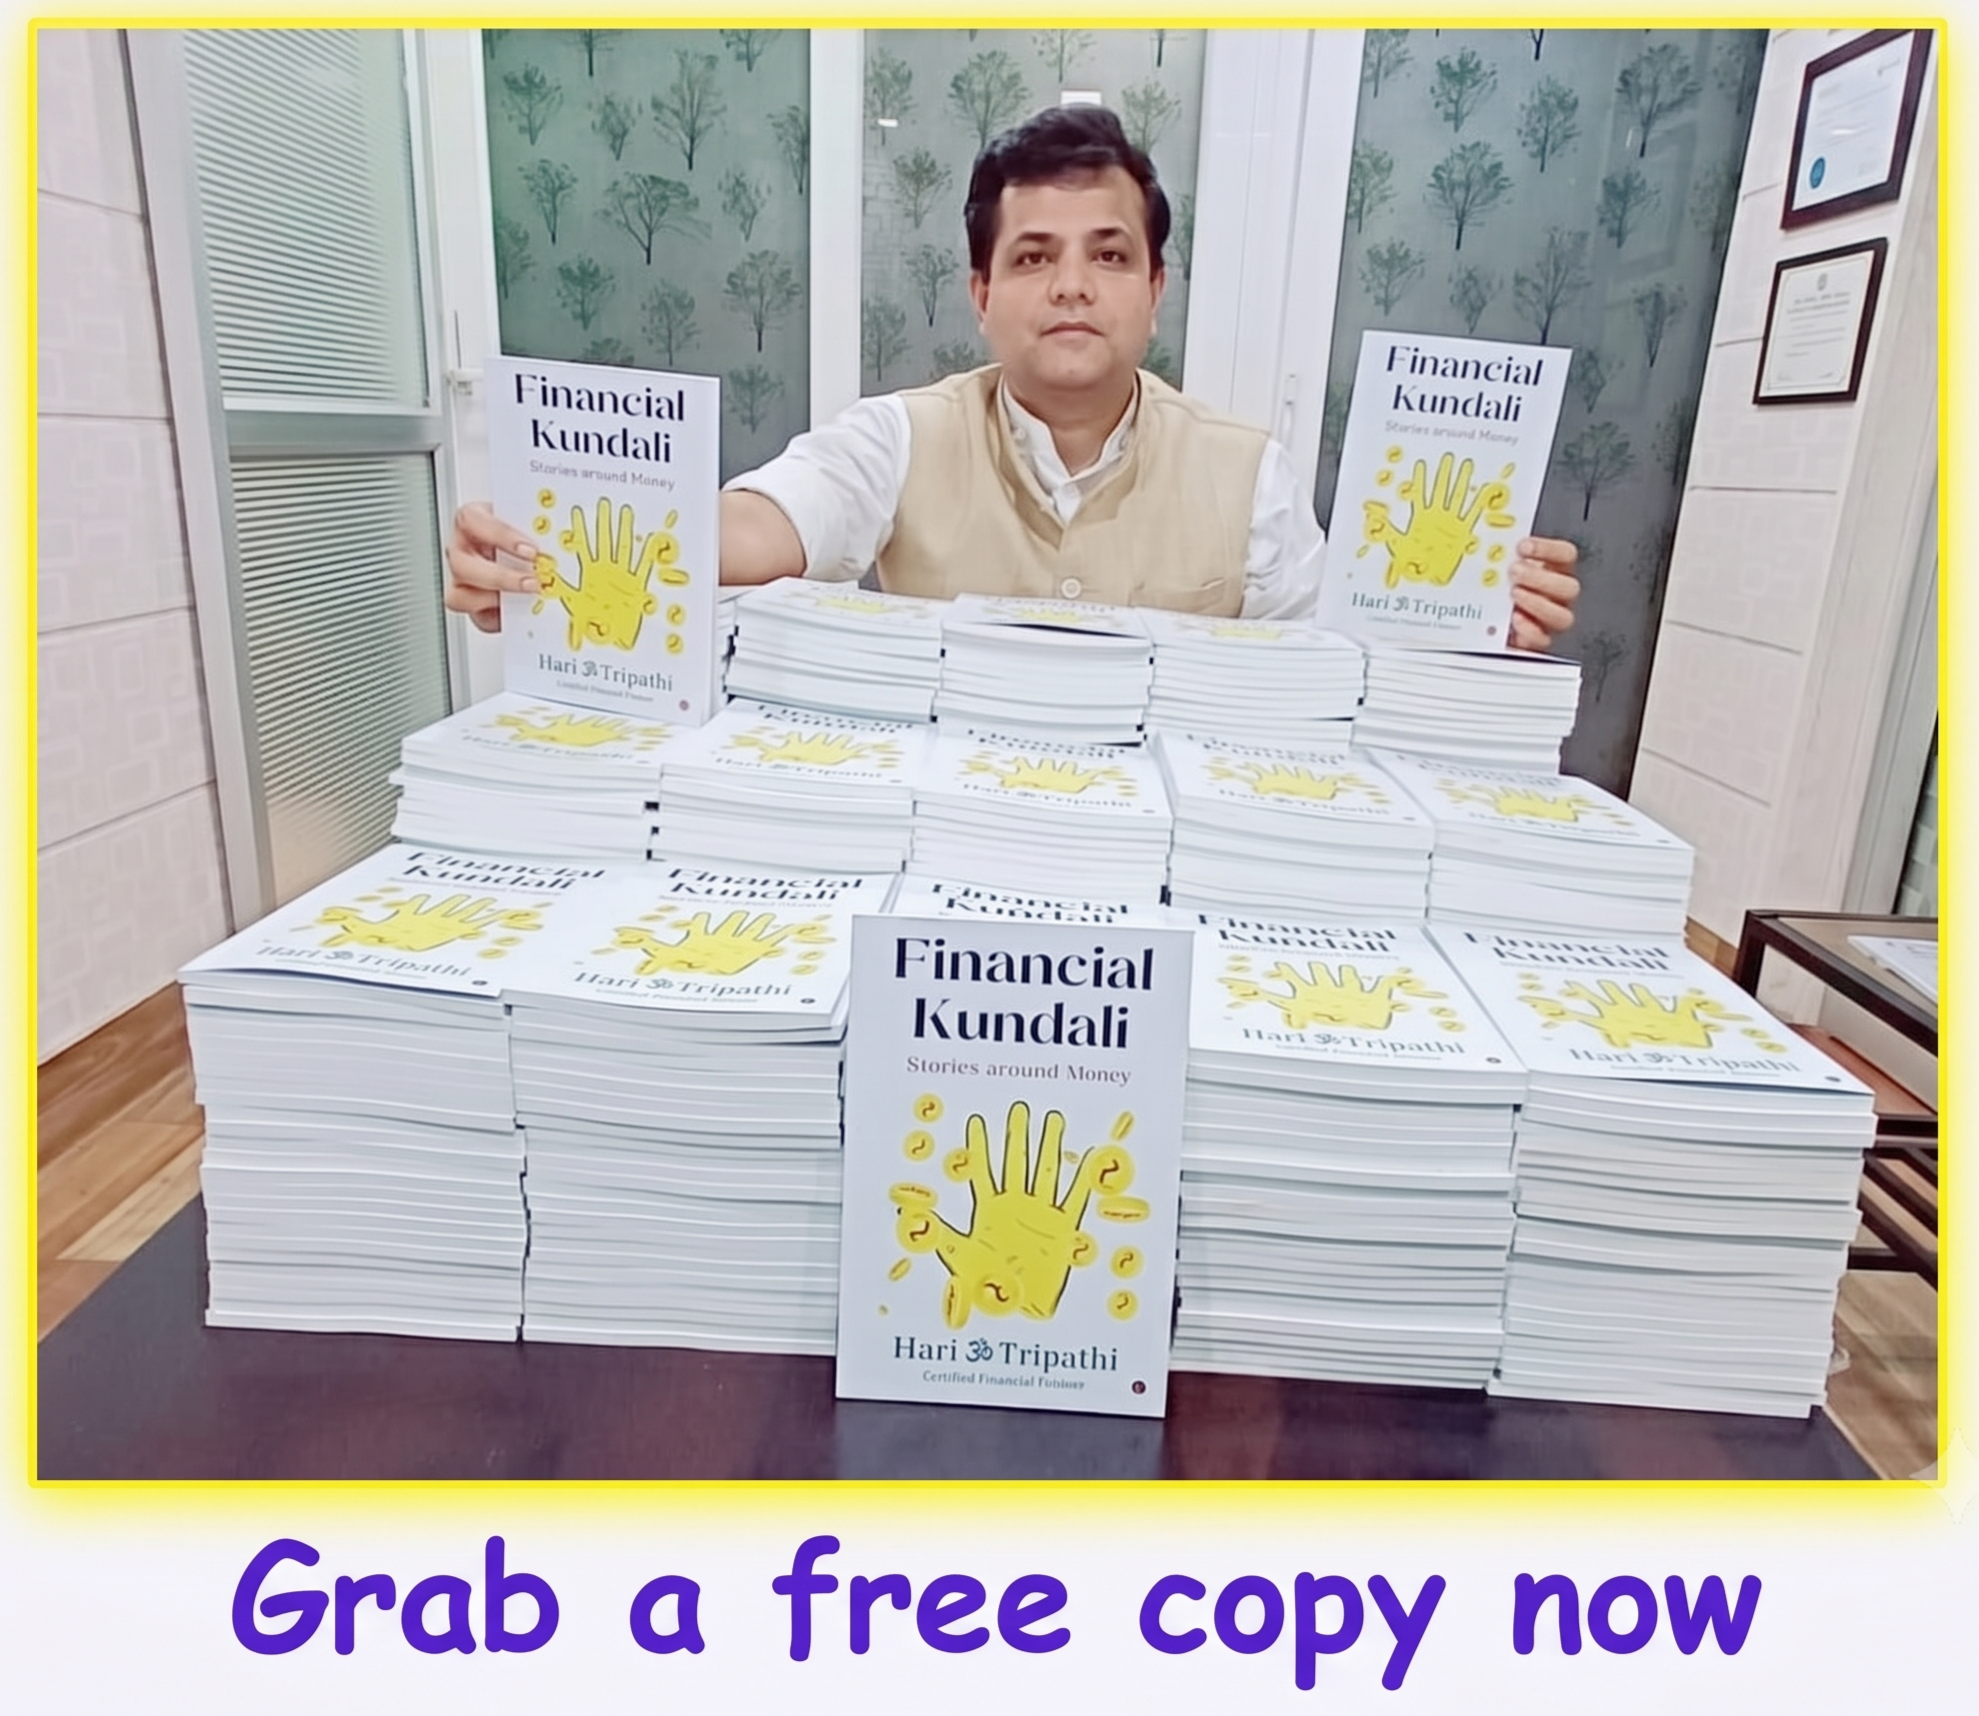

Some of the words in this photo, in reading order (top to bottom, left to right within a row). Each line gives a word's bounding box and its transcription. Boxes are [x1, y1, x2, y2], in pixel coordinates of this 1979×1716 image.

[1386, 345, 1543, 387] Financial
[514, 374, 685, 421] Financial
[1392, 383, 1522, 422] Kundali
[531, 419, 672, 463] Kundali
[529, 460, 578, 479] Stories
[582, 468, 628, 484] around
[631, 472, 675, 491] Money
[1351, 592, 1390, 610] Hari
[1413, 599, 1483, 620] Tripathi
[538, 654, 577, 675] Hari
[600, 664, 673, 692] Tripathi
[667, 868, 864, 889] Financial
[671, 882, 840, 901] Kundali
[894, 937, 1154, 990] Financial
[574, 971, 640, 989] Hari
[678, 981, 793, 998] Tripathi
[914, 998, 1129, 1049] Kundali
[906, 1056, 980, 1076] Stories
[986, 1061, 1059, 1080] around
[1066, 1064, 1131, 1085] Money
[894, 1336, 957, 1362] Hari
[999, 1341, 1119, 1374] Tripathi
[922, 1370, 976, 1385] Certified
[978, 1374, 1035, 1388] Financial
